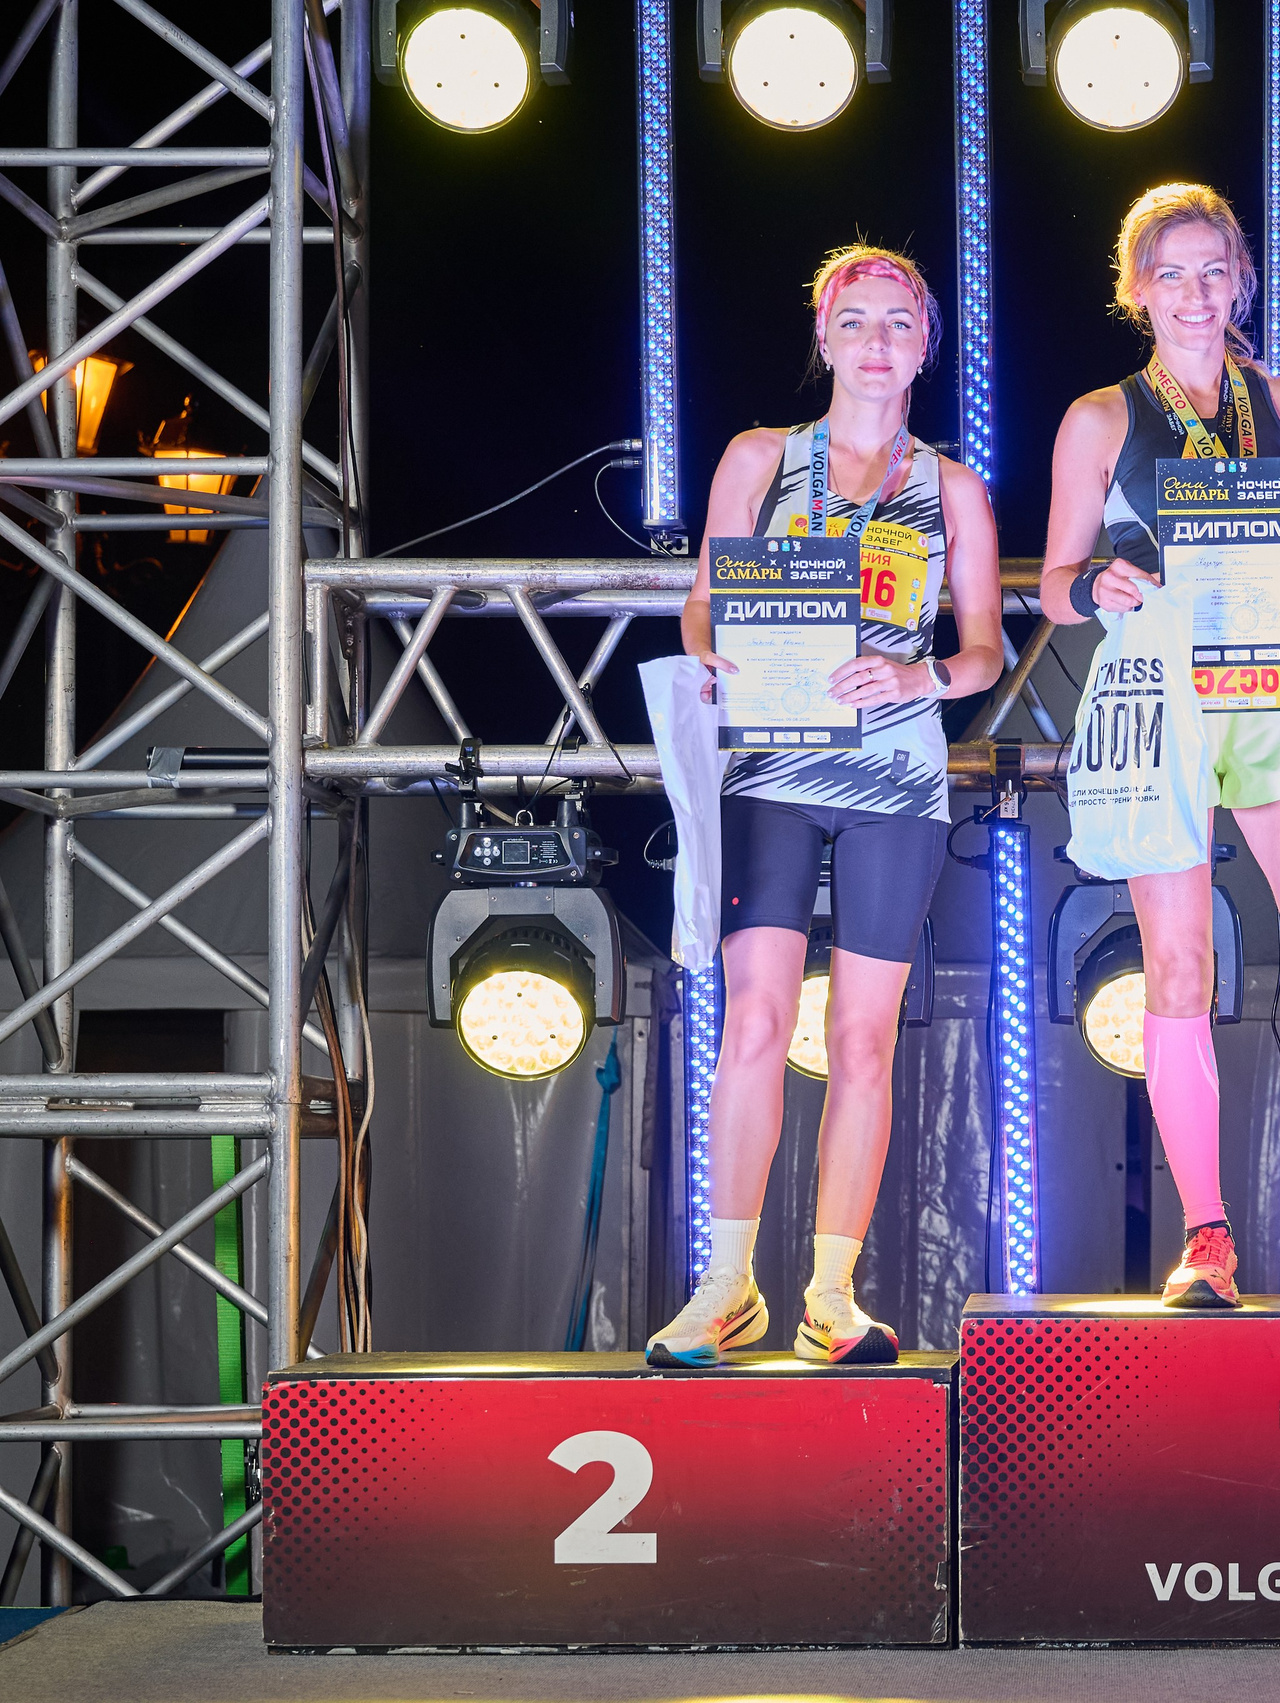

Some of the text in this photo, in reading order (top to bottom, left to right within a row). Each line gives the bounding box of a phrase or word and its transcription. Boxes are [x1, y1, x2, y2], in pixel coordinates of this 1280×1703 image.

[1151, 362, 1187, 410] 1 МЕСТО
[1197, 437, 1216, 459] VO
[1163, 476, 1209, 490] Огни
[812, 451, 825, 531] VOLGAMAN
[1165, 489, 1230, 501] САМАРЫ
[1237, 491, 1280, 500] ЗАБЕГ
[866, 526, 913, 541] НОЧНОЙ
[865, 535, 902, 547] ЗАБЕГ
[716, 555, 761, 568] Огни
[790, 558, 846, 569] НОЧНОЙ
[717, 568, 782, 580] САМАРЫ
[790, 571, 834, 580] ЗАБЕГ
[724, 601, 847, 622] ДИПЛОМ
[548, 1430, 657, 1564] 2
